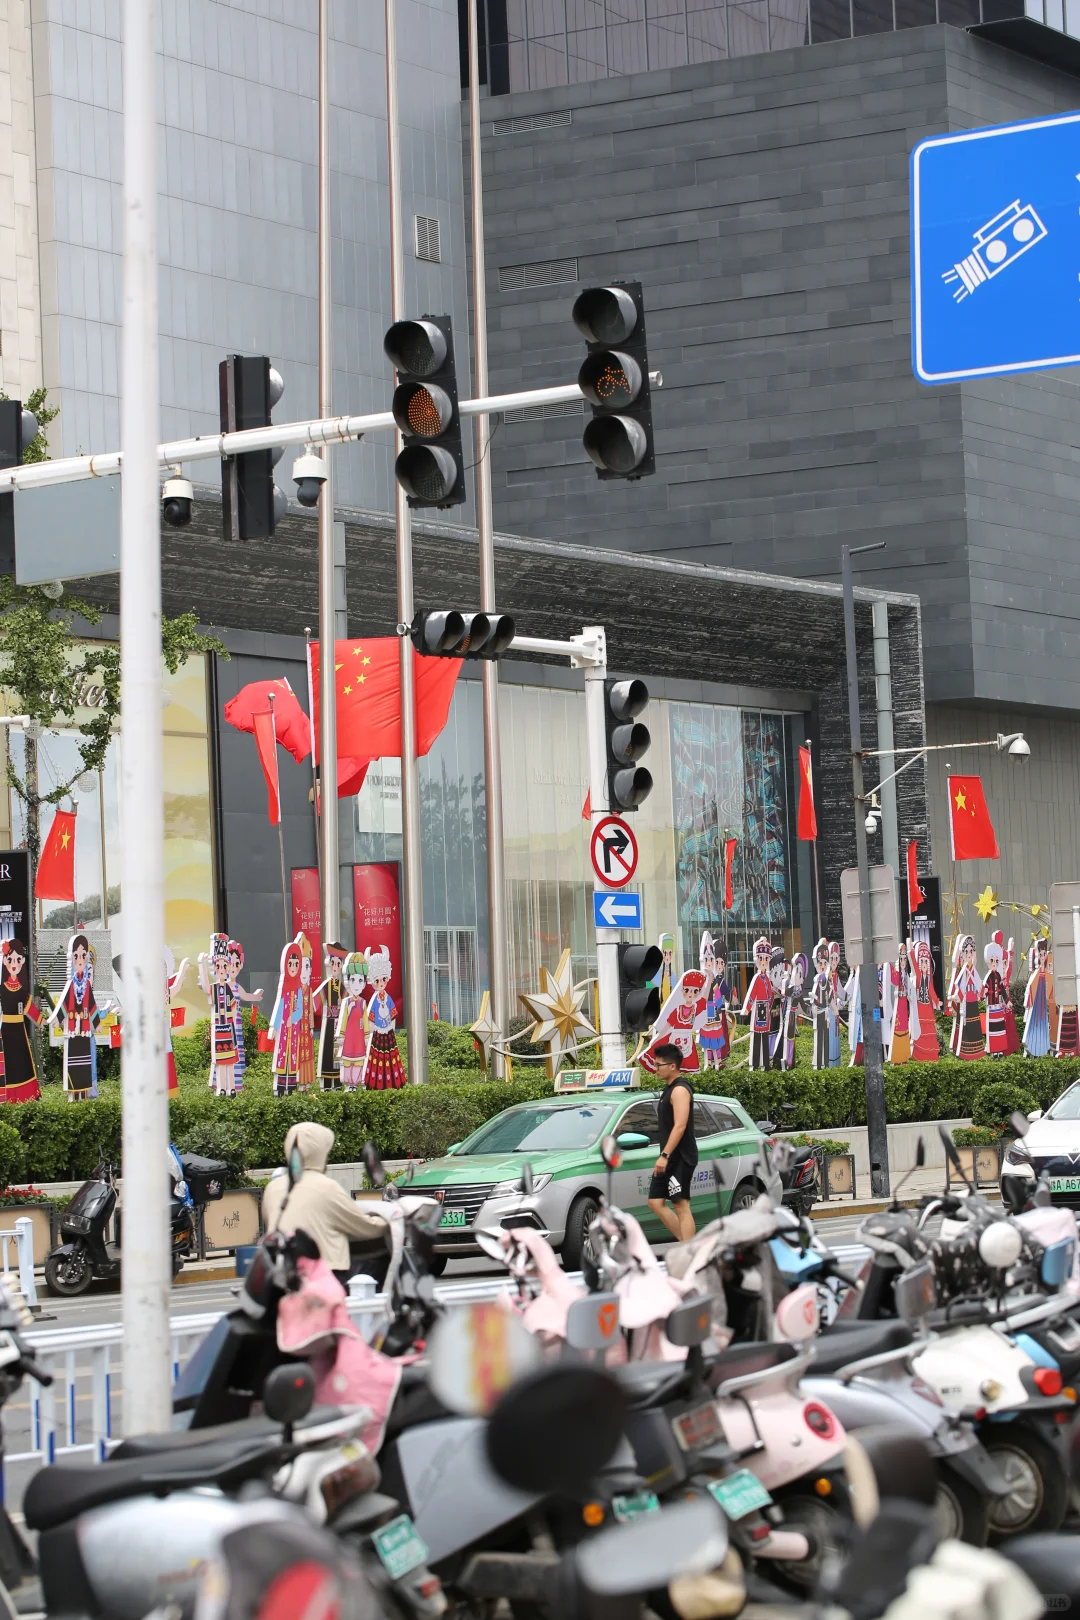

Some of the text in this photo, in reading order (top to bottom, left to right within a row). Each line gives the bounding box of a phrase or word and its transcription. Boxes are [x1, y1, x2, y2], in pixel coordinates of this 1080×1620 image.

[364, 917, 392, 926] 盛世华章
[611, 1071, 631, 1083] TAXI
[440, 1211, 464, 1224] 5337
